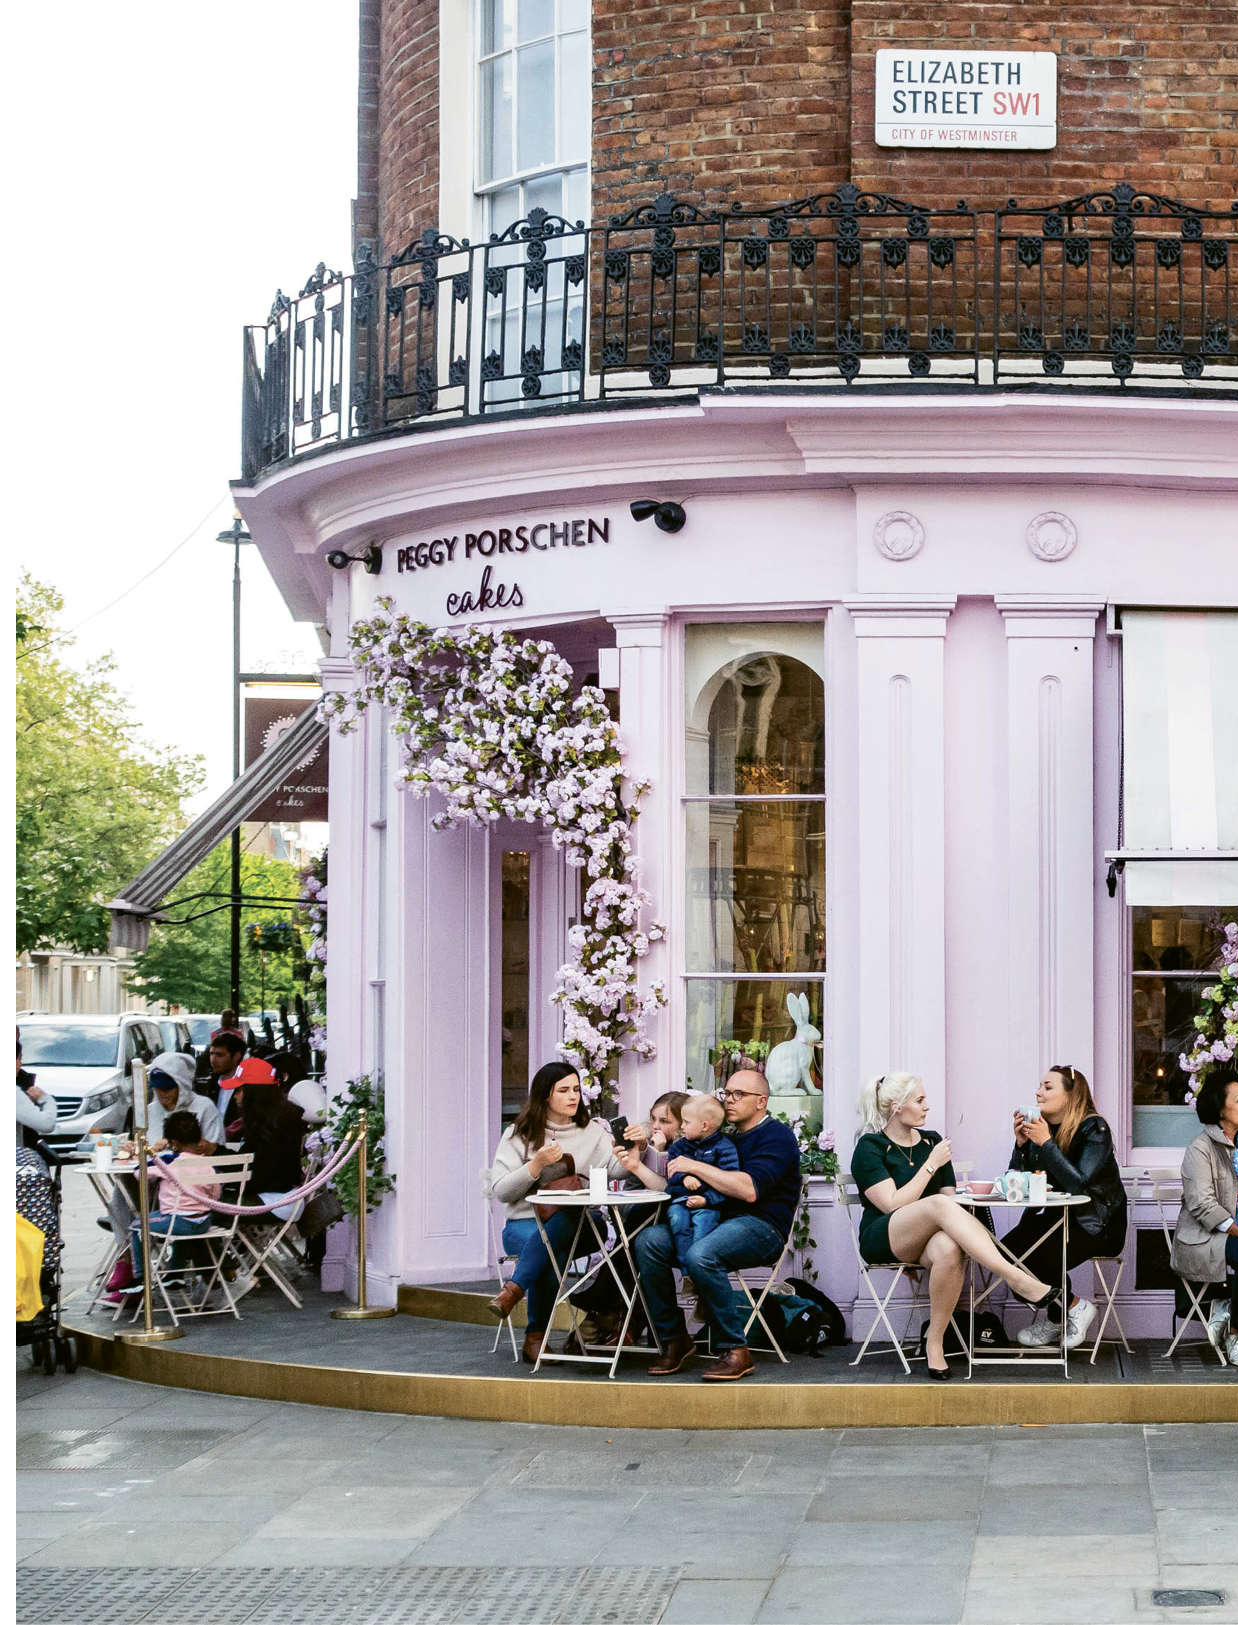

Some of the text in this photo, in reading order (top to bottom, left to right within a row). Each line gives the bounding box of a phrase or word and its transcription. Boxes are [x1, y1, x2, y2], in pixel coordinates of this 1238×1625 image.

[893, 60, 1021, 85] ELIZABETH
[892, 90, 1040, 116] STREET SW1
[892, 128, 1018, 142] CITY OF WESTMINSTER
[397, 517, 610, 573] PEGGY PORSCHEN
[446, 565, 524, 616] cakes
[981, 1330, 993, 1338] EY
